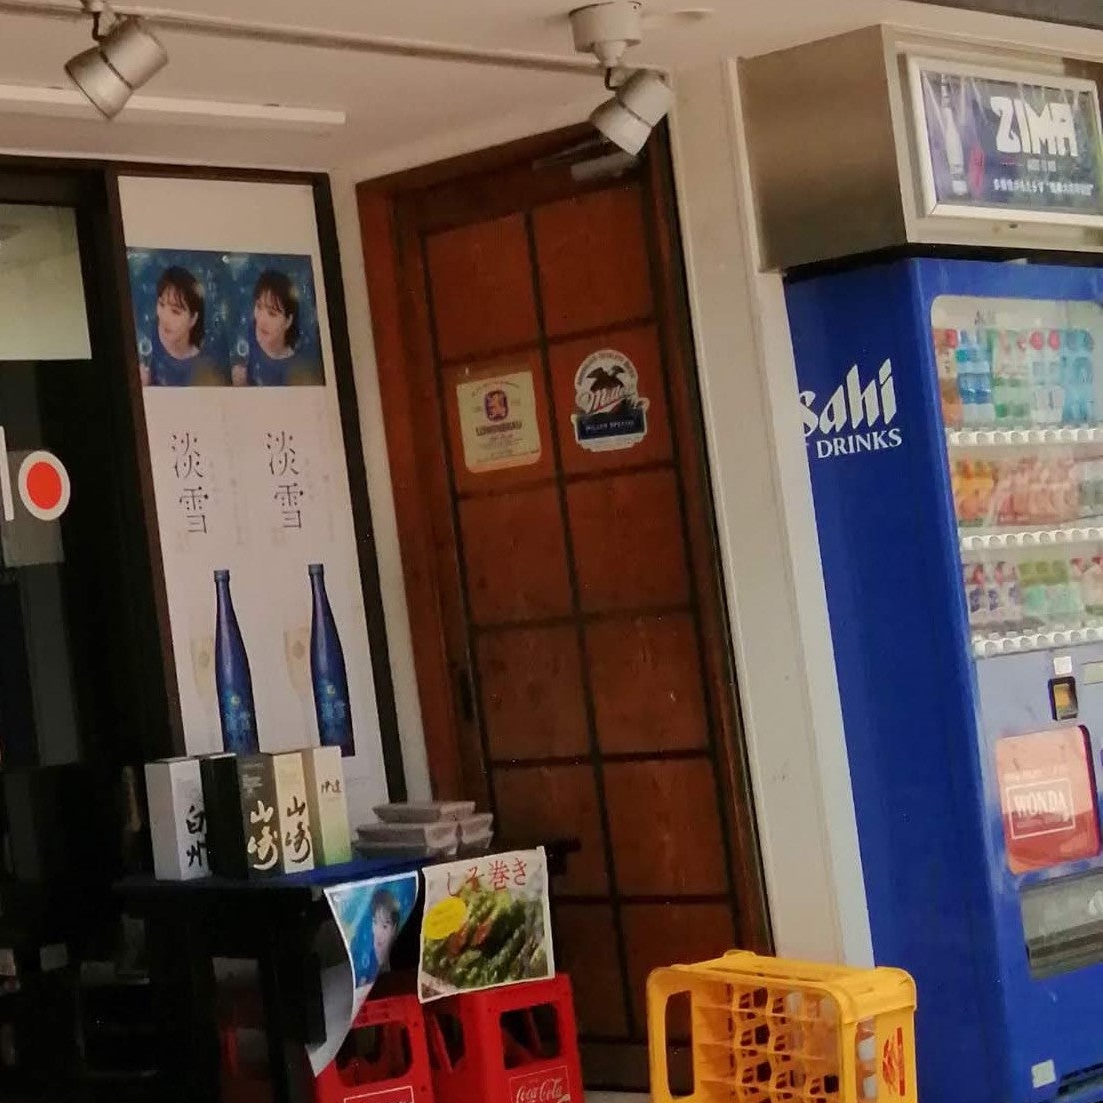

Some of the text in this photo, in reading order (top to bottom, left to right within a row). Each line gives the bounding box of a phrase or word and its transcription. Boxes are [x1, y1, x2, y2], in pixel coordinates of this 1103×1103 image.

[990, 96, 1078, 157] ZIMA
[799, 357, 897, 438] sahi
[816, 428, 903, 459] DRINKS
[171, 432, 210, 534] 淡雪
[265, 431, 304, 529] 淡雪
[446, 857, 528, 897] しそ巻き
